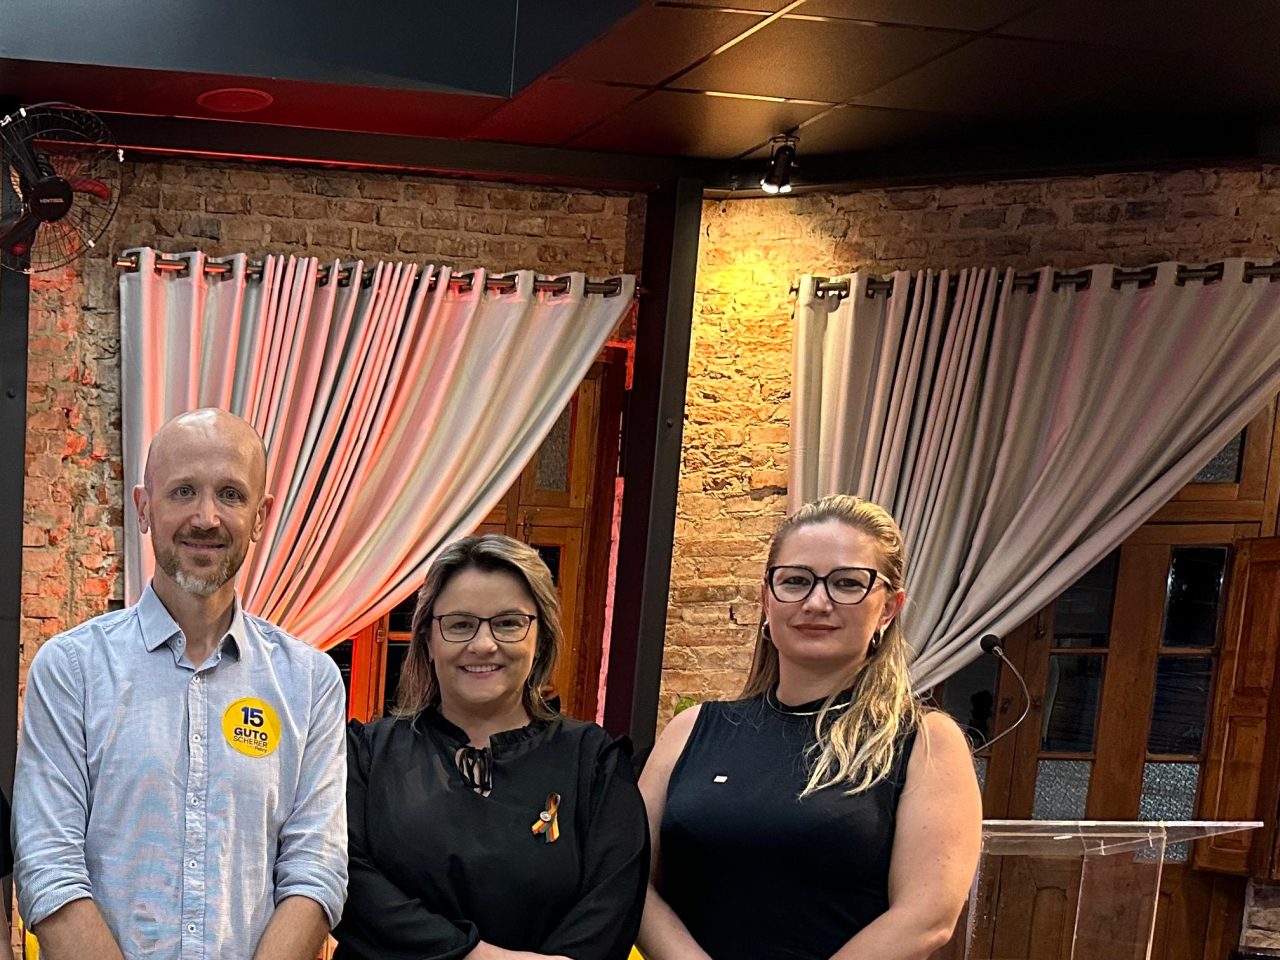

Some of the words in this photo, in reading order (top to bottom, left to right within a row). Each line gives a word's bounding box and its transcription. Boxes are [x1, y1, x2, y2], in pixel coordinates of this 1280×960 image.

[241, 706, 264, 727] 15
[234, 727, 268, 741] GUTO
[233, 736, 268, 748] SCHERER
